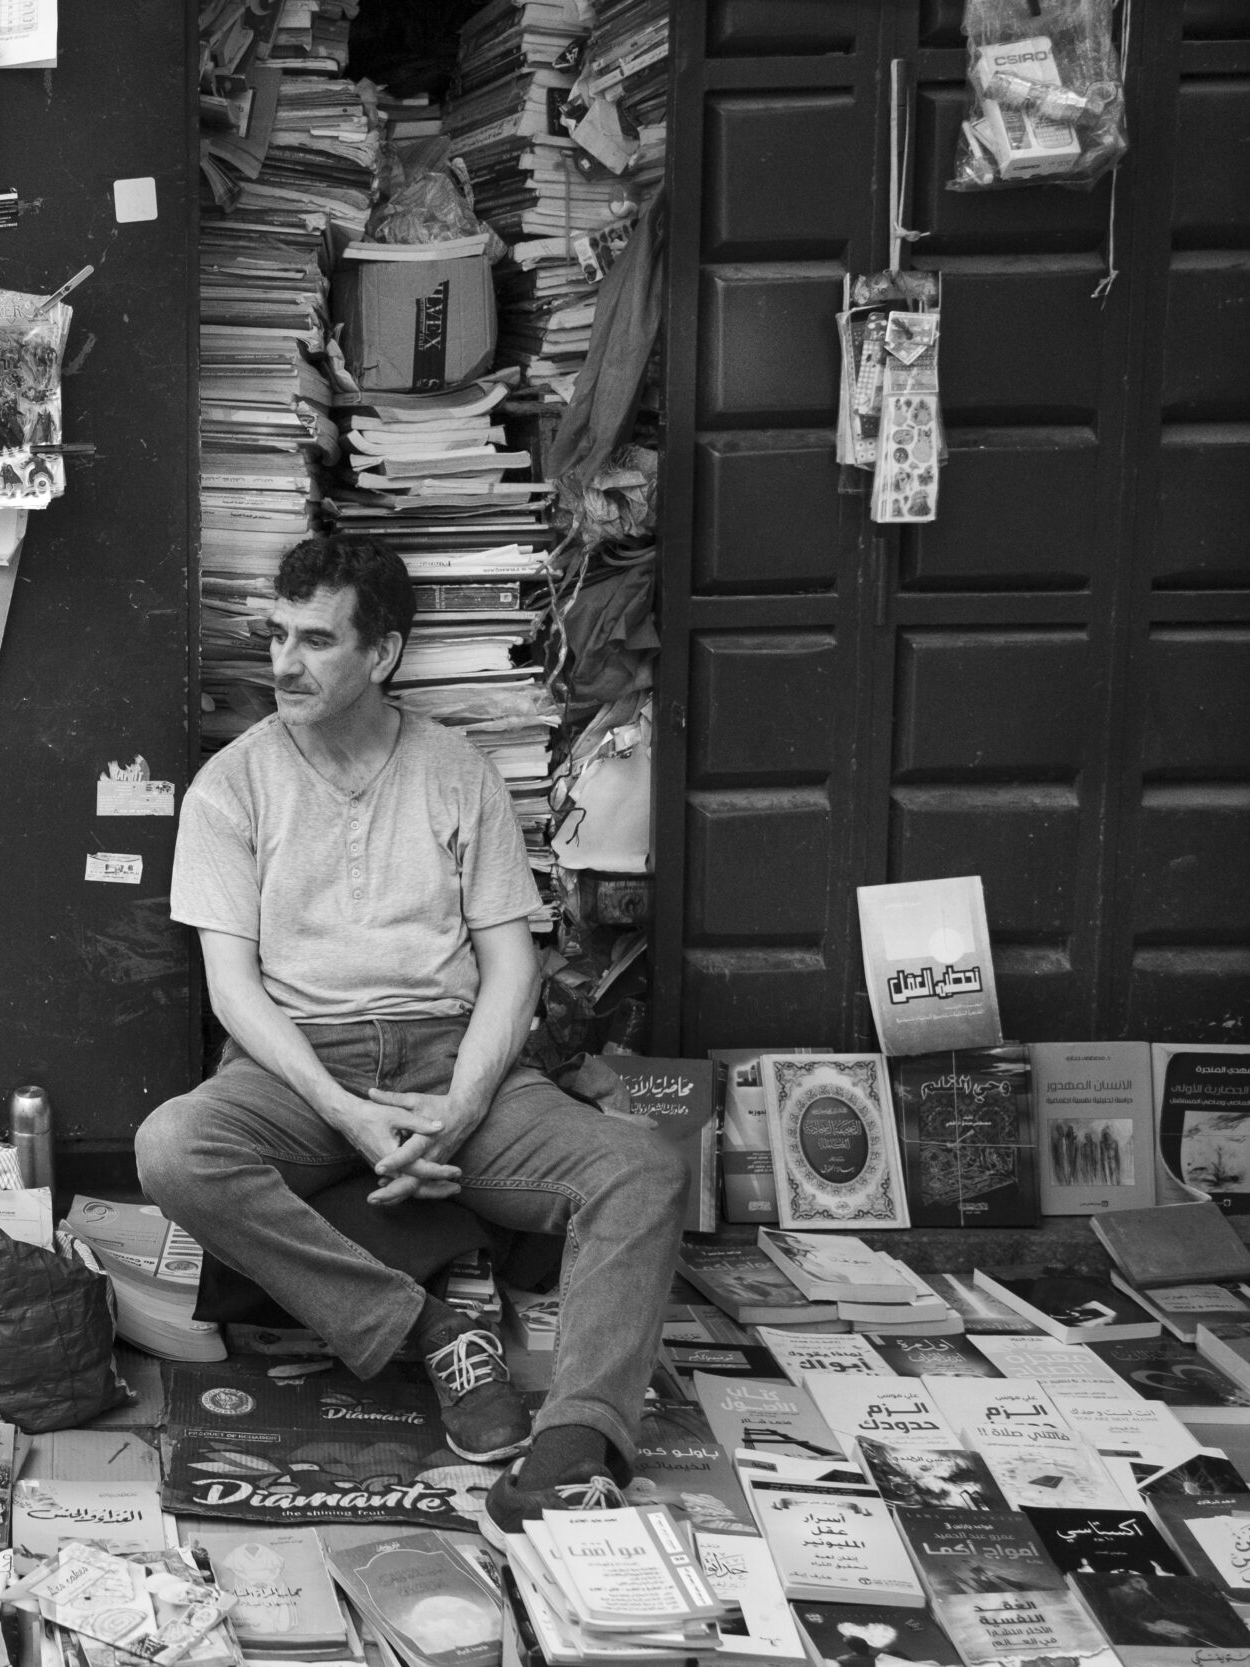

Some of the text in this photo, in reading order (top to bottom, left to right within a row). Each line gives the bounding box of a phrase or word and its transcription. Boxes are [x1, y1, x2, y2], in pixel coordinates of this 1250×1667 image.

[993, 51, 1046, 66] CSIRO
[1195, 1065, 1226, 1074] المنجرة
[1047, 1080, 1092, 1093] المهدور
[322, 1406, 426, 1425] Diamante
[867, 1401, 930, 1418] الزم
[985, 1404, 1048, 1420] الزم
[858, 1418, 940, 1434] حدودك
[188, 1430, 224, 1438] PRODUCT
[238, 1433, 278, 1441] ECUADOR
[672, 1447, 719, 1460] باولو
[192, 1478, 449, 1512] Diamante
[282, 1509, 302, 1517] the
[306, 1509, 352, 1517] shining
[802, 1512, 846, 1525] أسرار
[811, 1526, 848, 1536] عقل
[922, 1539, 1039, 1560] أمواج أكما
[47, 1566, 89, 1596] Les cakes
[979, 1614, 1046, 1628] النفسية
